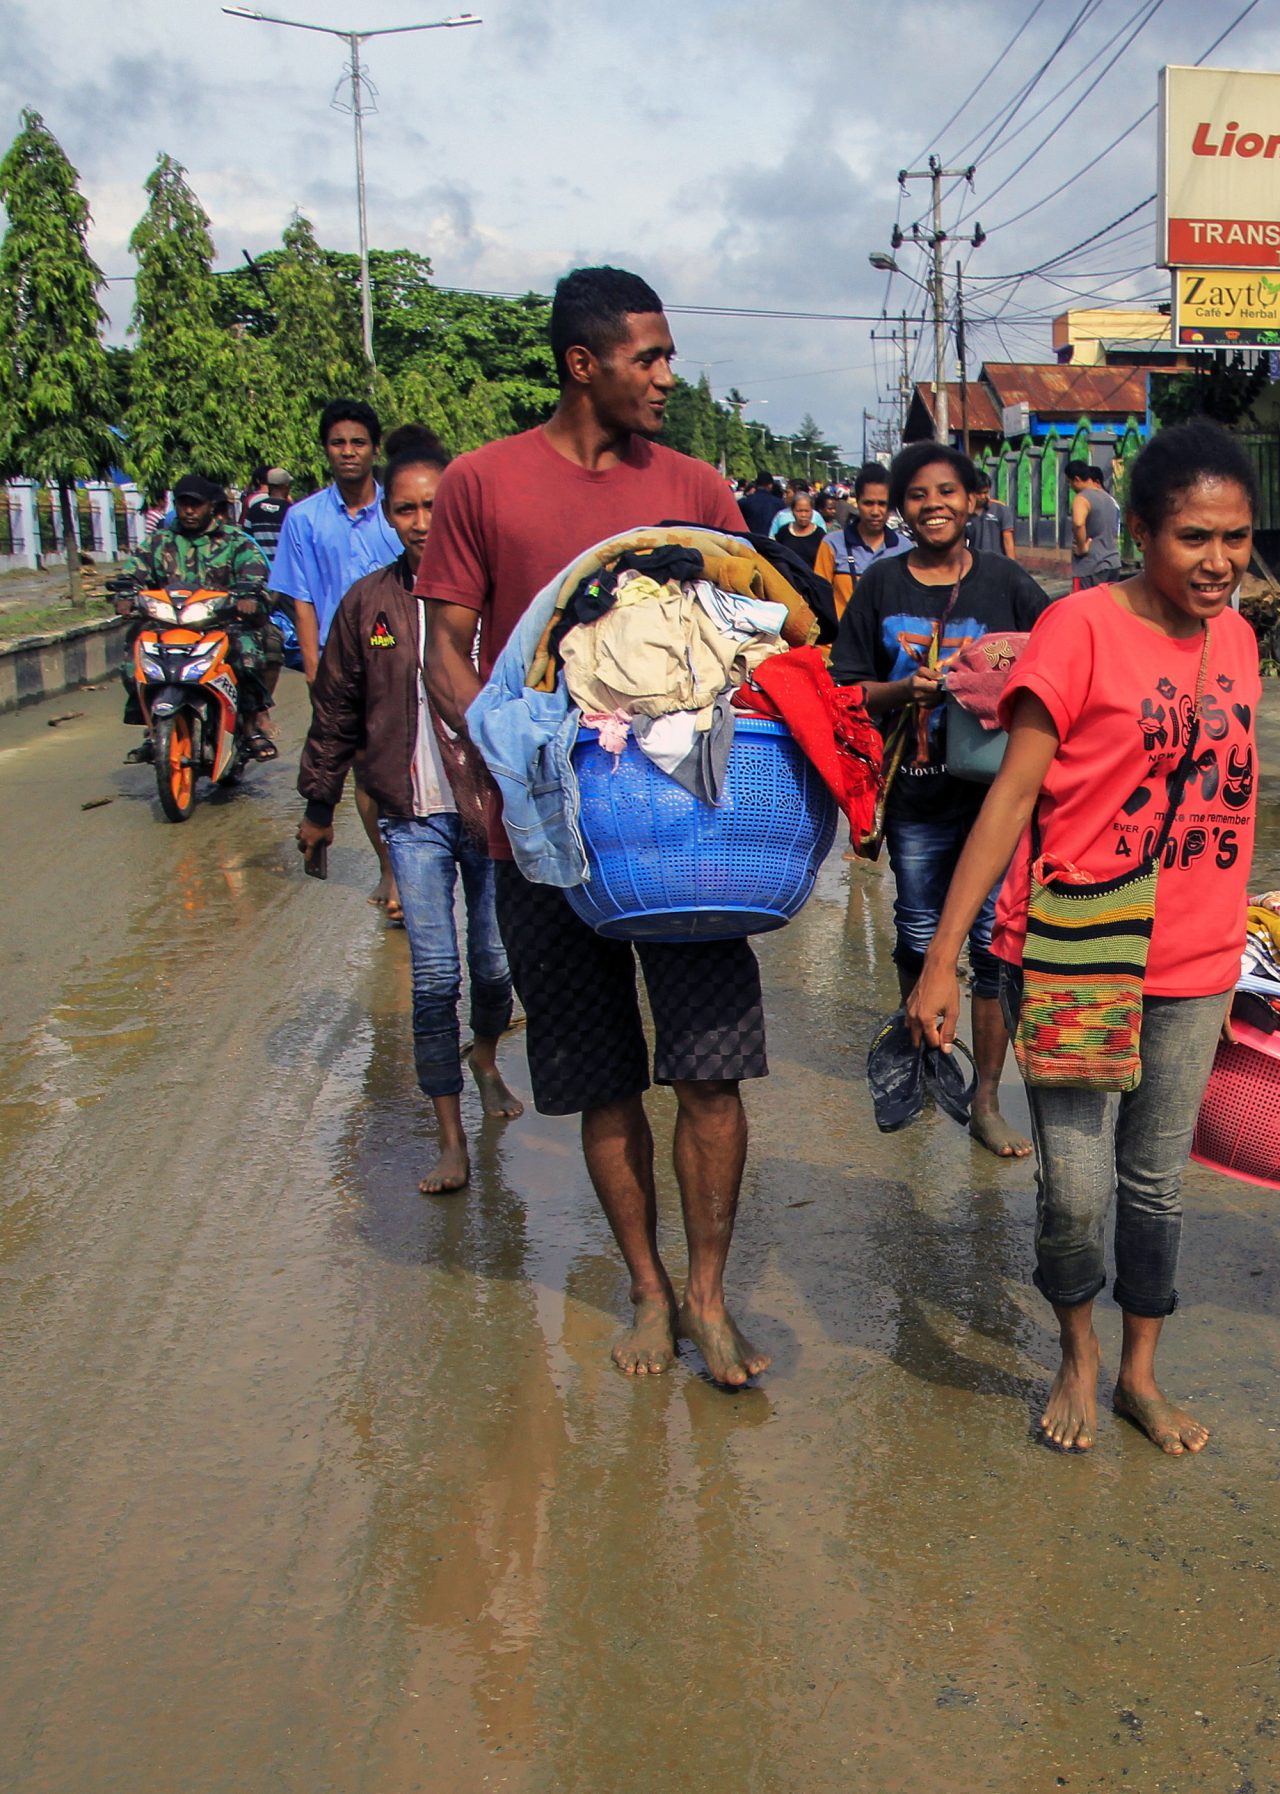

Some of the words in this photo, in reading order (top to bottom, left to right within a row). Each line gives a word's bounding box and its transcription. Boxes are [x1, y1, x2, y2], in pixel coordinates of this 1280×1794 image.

[1189, 222, 1280, 246] TRANS
[1196, 306, 1221, 318] Café
[1240, 308, 1277, 319] Herbal
[909, 766, 938, 777] LOVE
[1189, 814, 1205, 822] me
[1207, 813, 1251, 825] remember
[1113, 823, 1139, 833] EVER
[1115, 836, 1132, 857] 4
